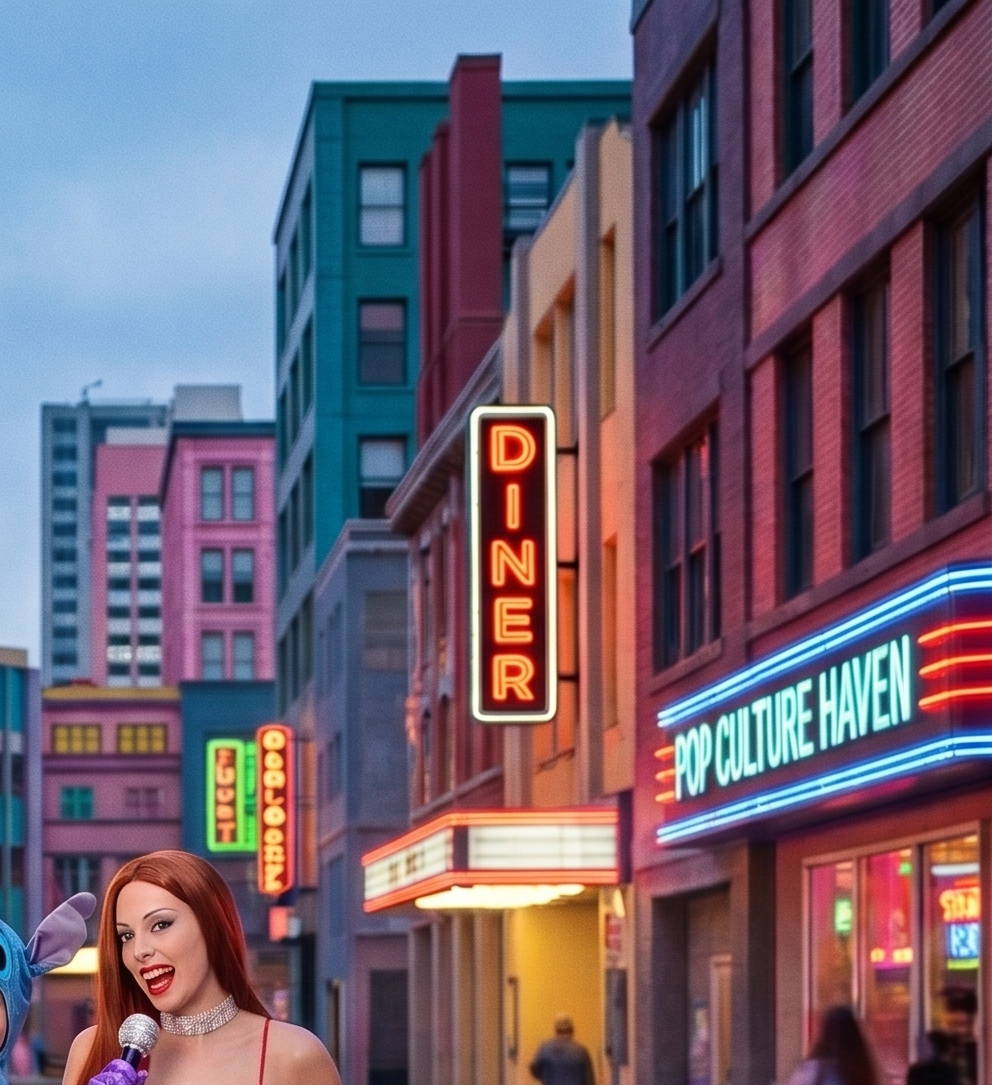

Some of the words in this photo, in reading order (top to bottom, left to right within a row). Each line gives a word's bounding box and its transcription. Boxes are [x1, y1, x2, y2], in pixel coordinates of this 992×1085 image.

[490, 425, 537, 702] DINER
[674, 722, 713, 802] POP
[715, 677, 815, 788] CULTURE
[818, 633, 911, 751] HAVEN
